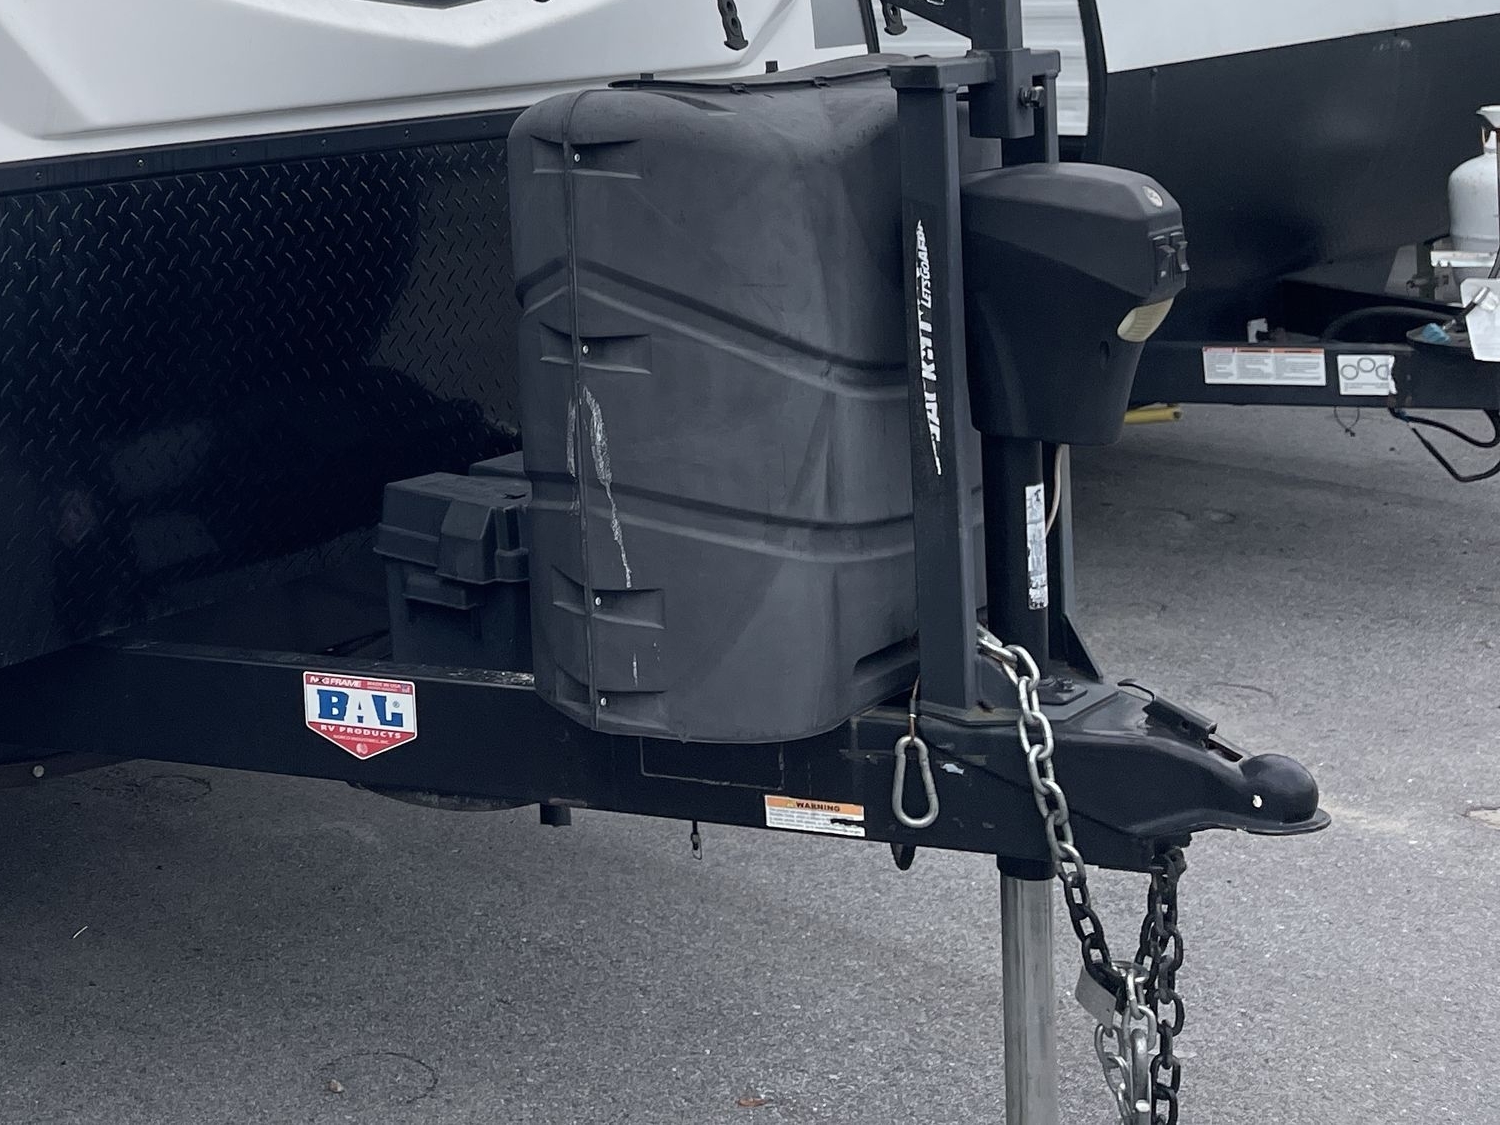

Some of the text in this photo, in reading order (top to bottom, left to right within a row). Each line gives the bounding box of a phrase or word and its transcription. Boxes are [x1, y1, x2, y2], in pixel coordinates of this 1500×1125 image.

[317, 689, 403, 728] BAL
[320, 724, 402, 739] RV PRODUCTS
[796, 801, 840, 812] WARNING
